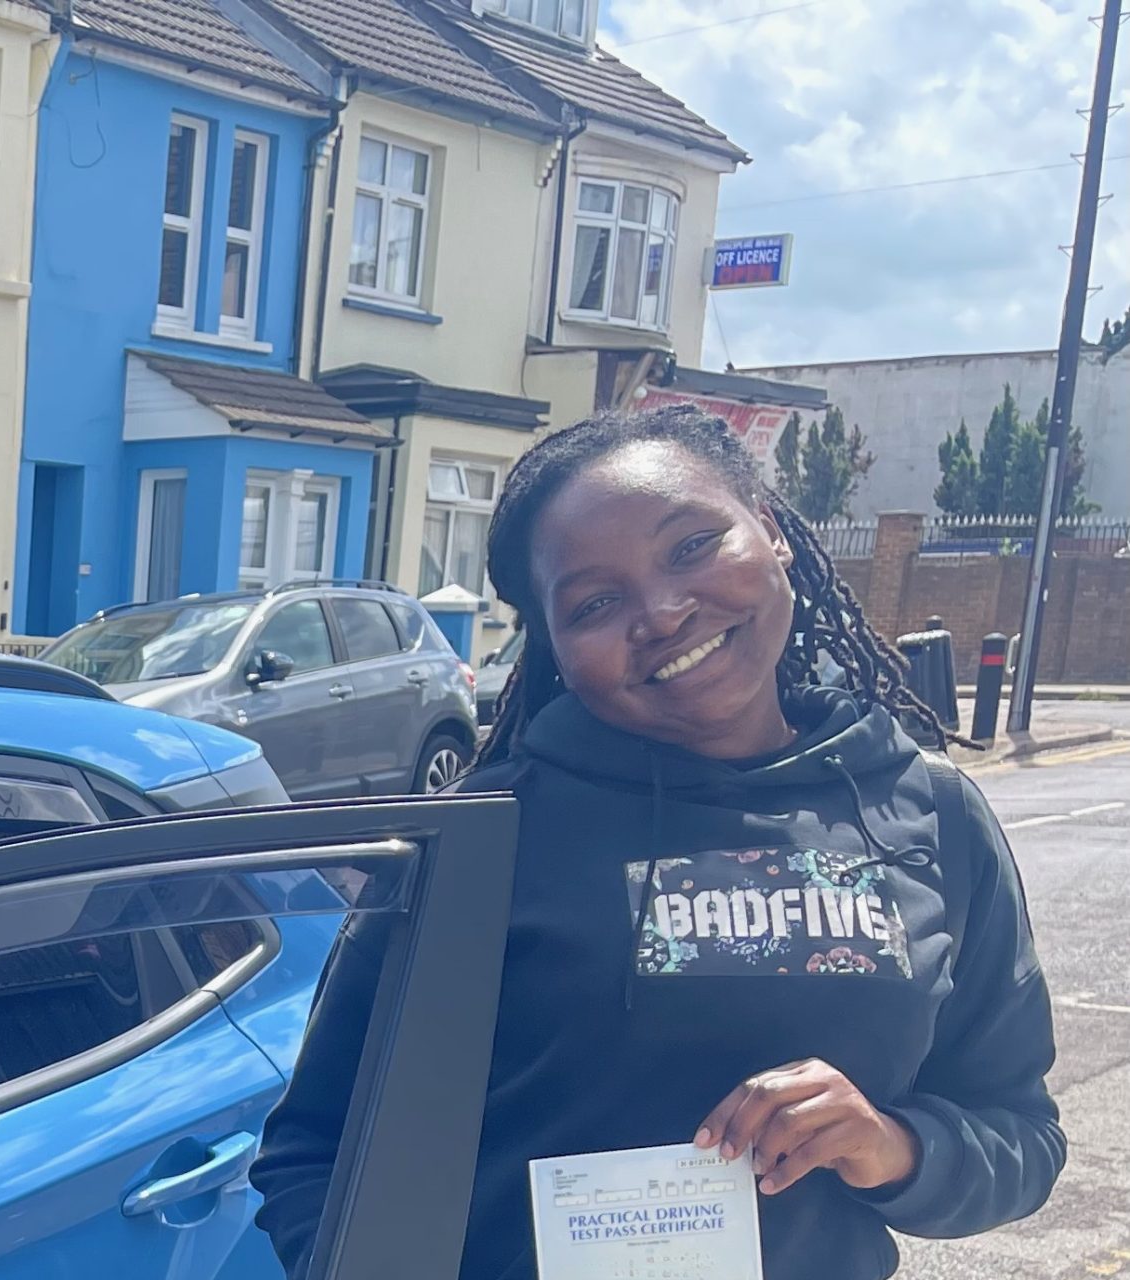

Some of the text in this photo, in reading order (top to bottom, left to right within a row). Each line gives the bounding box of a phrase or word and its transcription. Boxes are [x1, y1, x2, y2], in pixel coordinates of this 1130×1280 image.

[716, 248, 780, 267] OFF LICENCE
[568, 1203, 724, 1228] PRACTICAL DRIVING
[571, 1217, 725, 1241] TEST PASS CERTIFICATE
